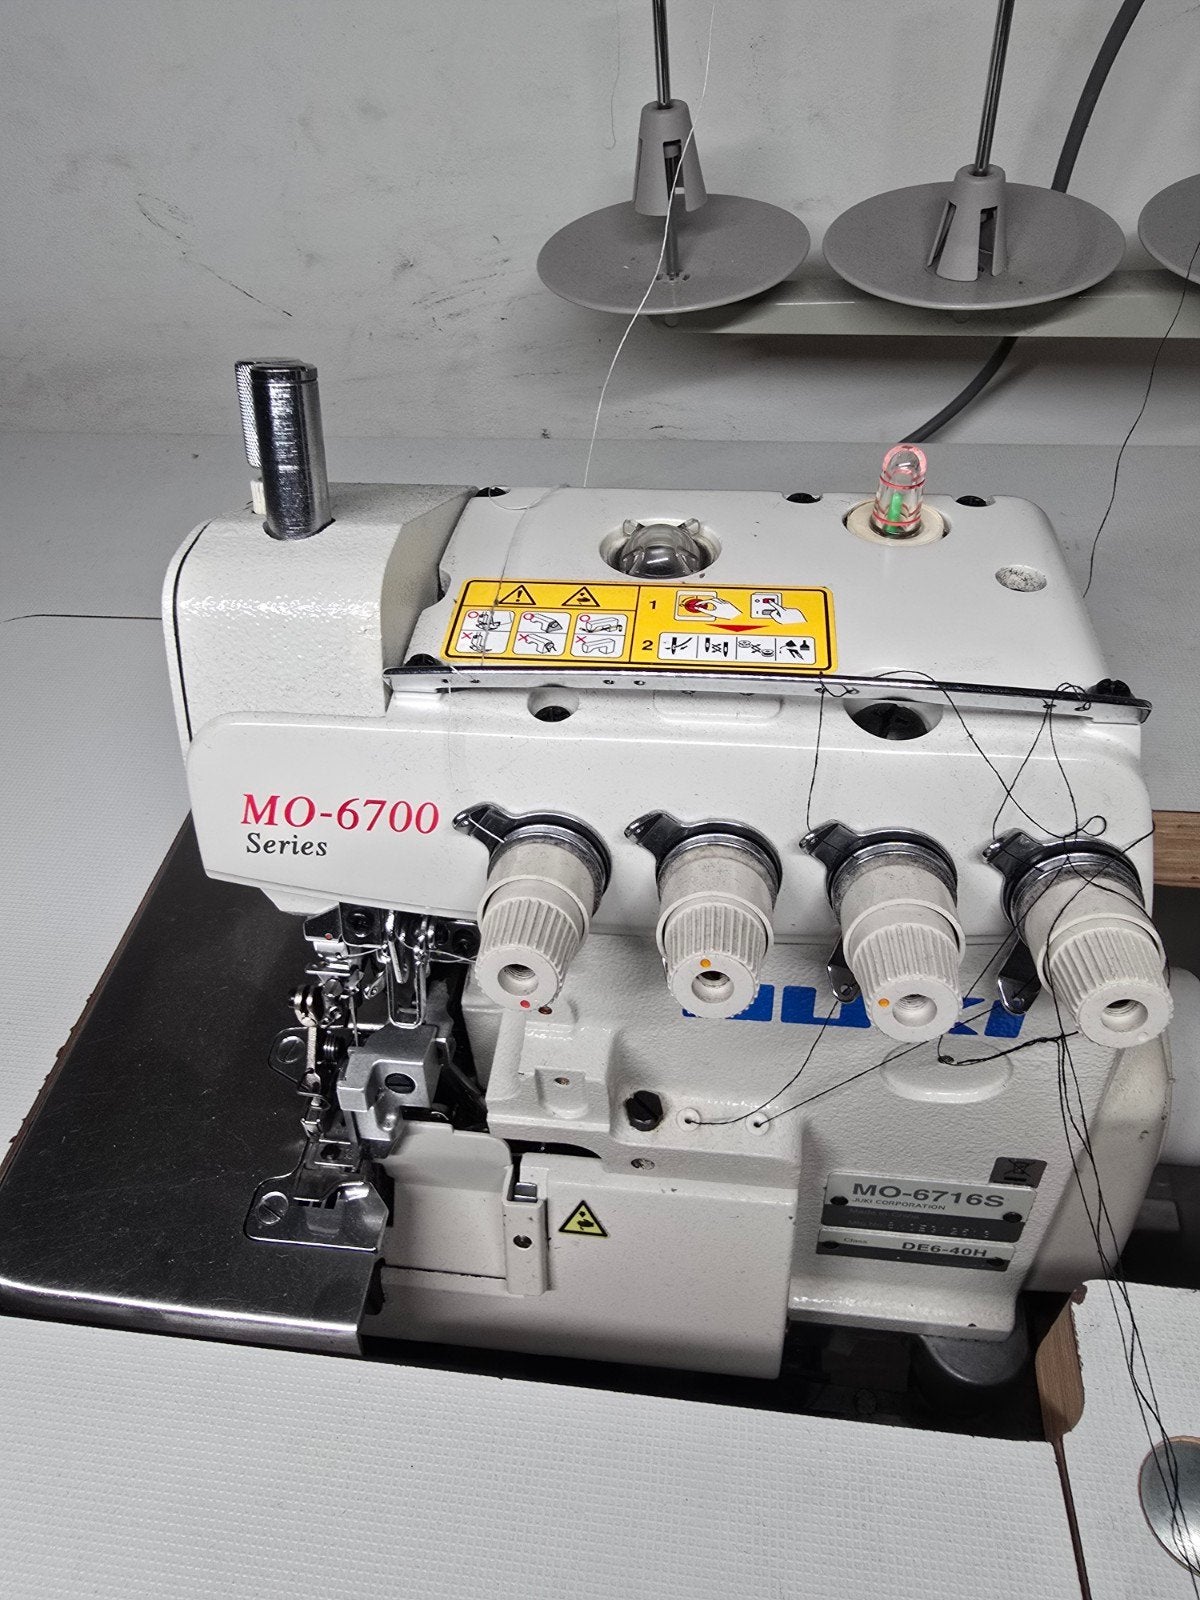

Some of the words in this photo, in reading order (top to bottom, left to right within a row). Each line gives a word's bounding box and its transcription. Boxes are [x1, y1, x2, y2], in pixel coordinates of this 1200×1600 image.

[649, 600, 657, 610] 1
[641, 639, 653, 651] 2
[240, 793, 440, 834] MO-6700
[246, 832, 328, 857] Series
[852, 1183, 1004, 1208] MO-6716S
[852, 1197, 872, 1205] JUKI
[875, 1199, 946, 1211] CORPORATION
[901, 1241, 988, 1258] DE6-40H
